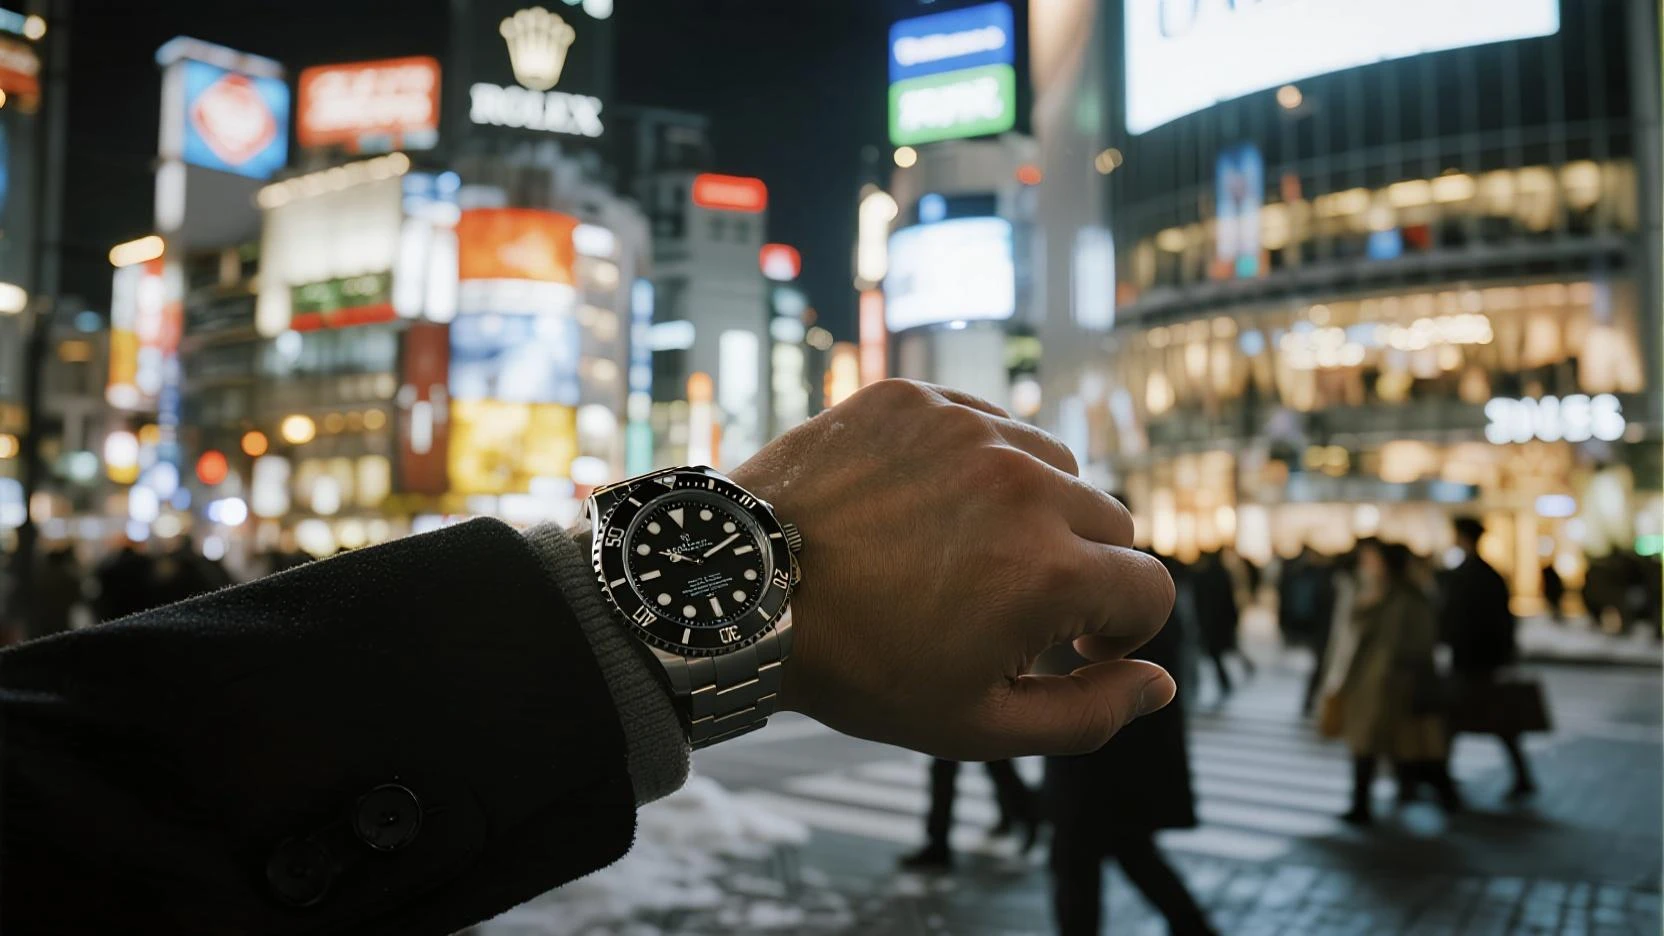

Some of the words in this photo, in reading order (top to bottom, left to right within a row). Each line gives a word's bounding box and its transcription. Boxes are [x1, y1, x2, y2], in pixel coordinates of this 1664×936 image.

[470, 82, 604, 138] ROLEX
[605, 527, 625, 547] 50
[773, 569, 788, 589] 20
